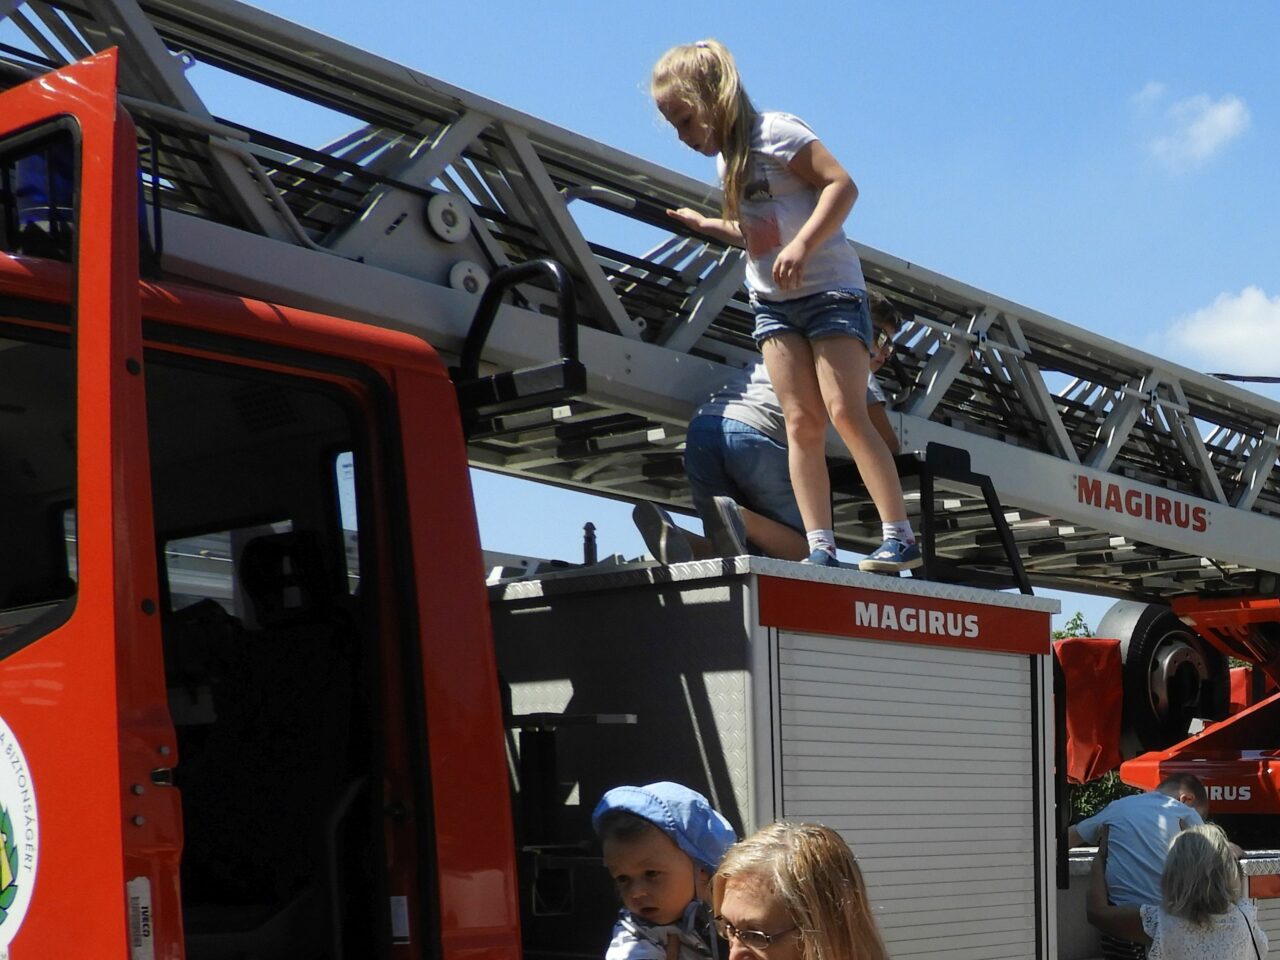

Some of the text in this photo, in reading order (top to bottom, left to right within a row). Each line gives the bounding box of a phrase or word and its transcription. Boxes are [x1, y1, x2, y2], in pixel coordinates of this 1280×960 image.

[1077, 475, 1207, 533] MAGIRUS
[854, 600, 979, 638] MAGIRUS
[141, 906, 151, 938] IVECO
